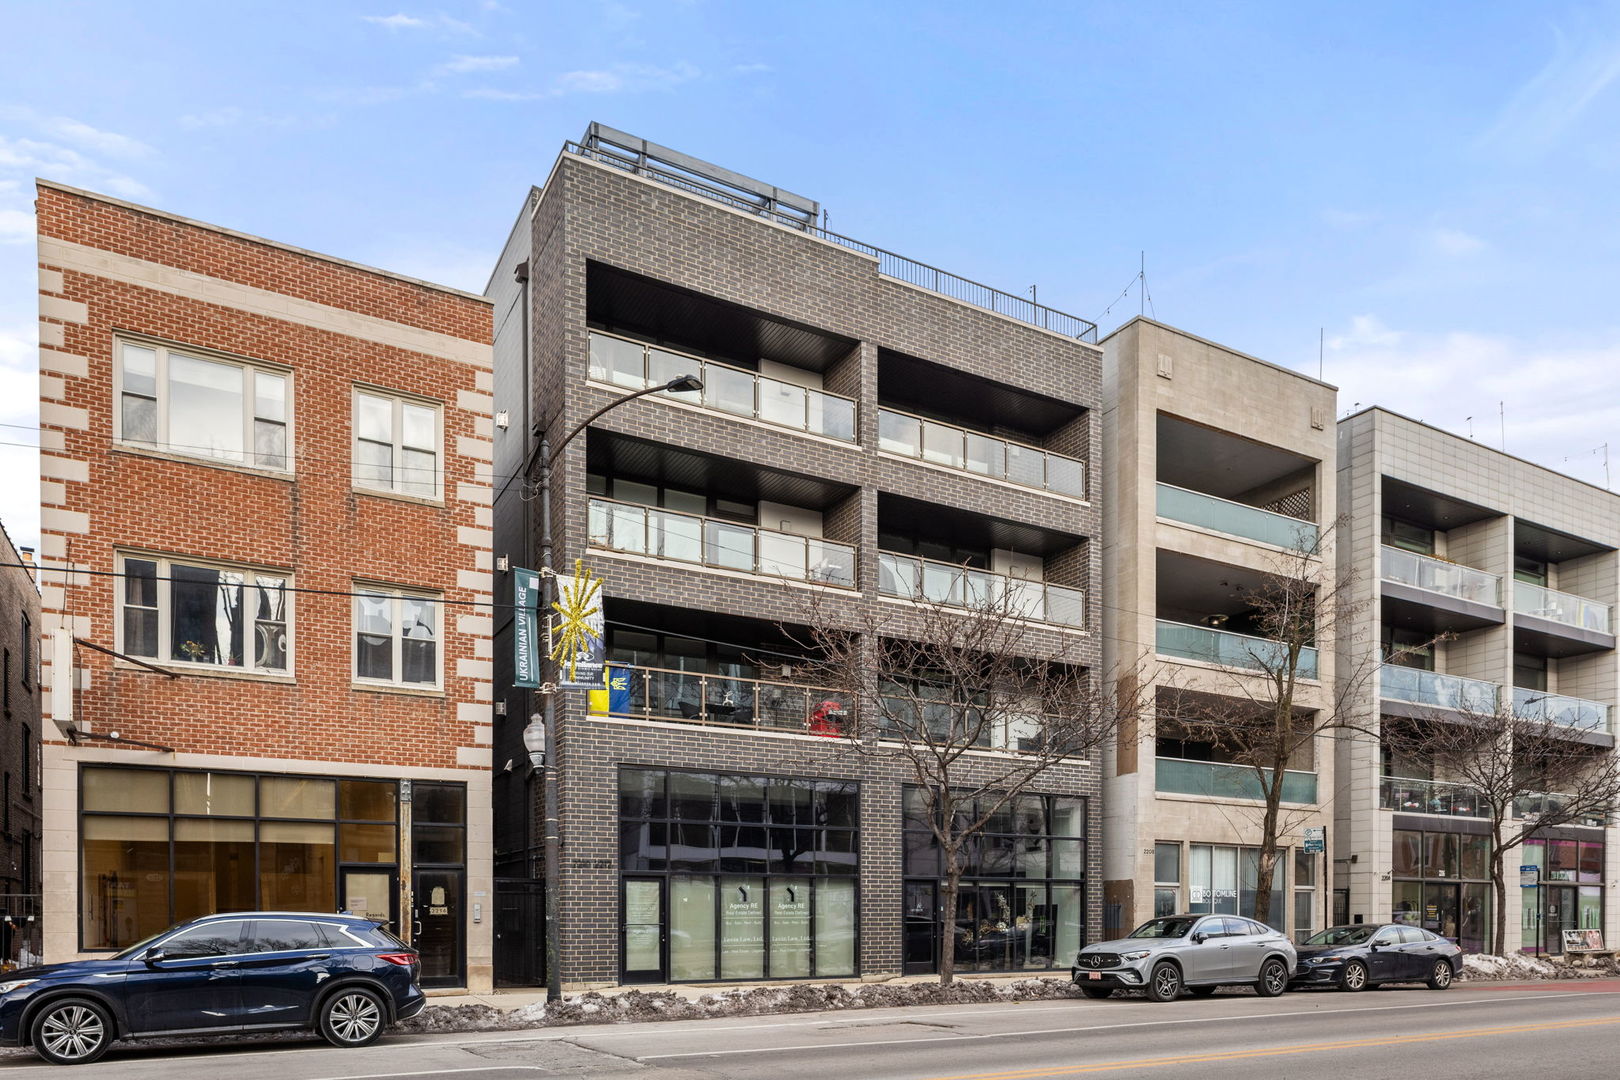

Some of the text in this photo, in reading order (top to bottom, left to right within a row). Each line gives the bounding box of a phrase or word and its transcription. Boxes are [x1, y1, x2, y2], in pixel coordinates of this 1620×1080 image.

[518, 587, 528, 681] UKRAINIAN VILLAGE
[1202, 890, 1237, 898] BOTOMLINE
